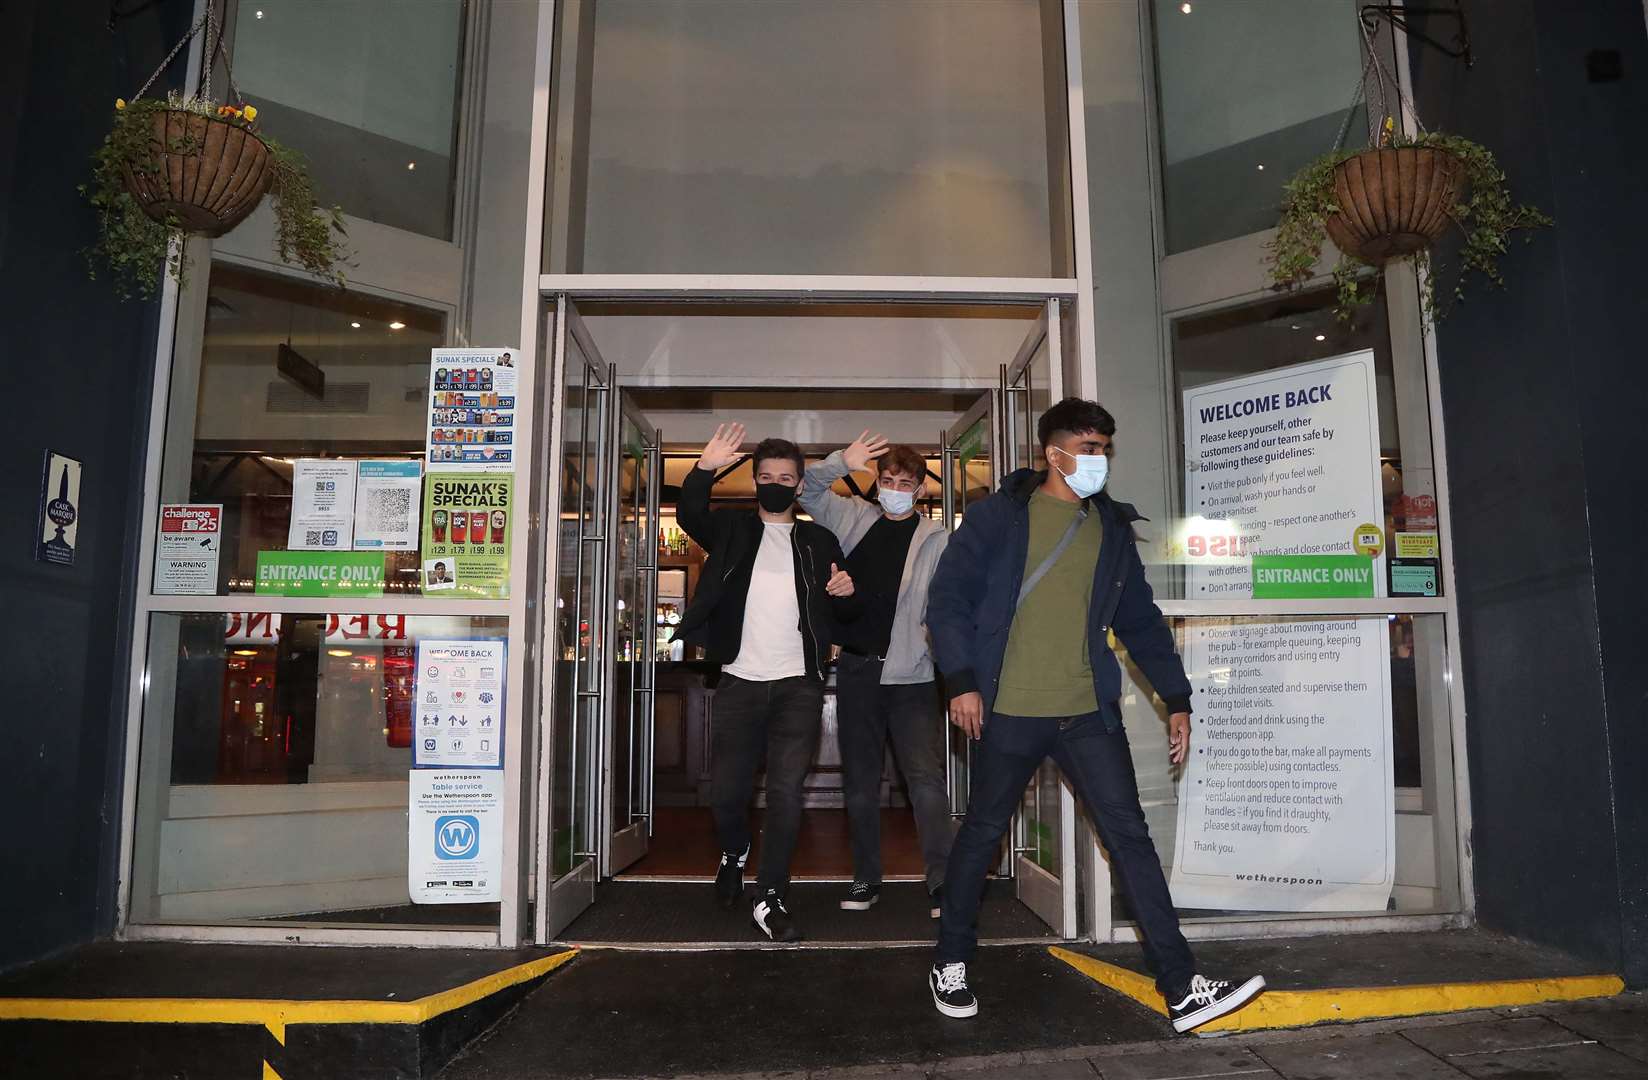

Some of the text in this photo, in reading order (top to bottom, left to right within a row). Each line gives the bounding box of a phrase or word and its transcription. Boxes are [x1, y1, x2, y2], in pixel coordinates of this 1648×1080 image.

[1200, 384, 1332, 423] WELCOME BACK
[1201, 418, 1311, 444] Please keep yourself, other
[1201, 428, 1334, 458] customers and our team safe by
[1201, 447, 1315, 472] following these guidelines:
[1208, 481, 1223, 491] Visit
[1224, 480, 1235, 489] the
[1237, 478, 1250, 489] pub
[1252, 474, 1268, 485] only
[1269, 472, 1274, 481] if
[1275, 471, 1290, 483] you
[1291, 468, 1305, 478] feel
[434, 482, 508, 495] SUNAK'S
[1208, 497, 1219, 507] On
[1244, 490, 1263, 501] wash
[1264, 488, 1281, 500] your
[1282, 484, 1306, 495] hands
[1308, 485, 1316, 493] or
[55, 502, 69, 512] CASK
[433, 496, 507, 506] SPECIALS
[50, 508, 74, 520] MARQUE
[165, 509, 211, 519] challenge
[1208, 511, 1221, 519] use
[1274, 509, 1356, 527] respect one another's
[199, 518, 216, 531] 25
[1284, 543, 1298, 554] and
[1300, 541, 1320, 553] close
[1321, 540, 1350, 551] contact
[260, 565, 381, 580] ENTRANCE ONLY
[1209, 566, 1224, 576] with
[1256, 567, 1370, 584] ENTRANCE ONLY
[1209, 581, 1252, 593] Don't arrang
[1209, 620, 1356, 638] Observe signage about moving around
[1209, 636, 1361, 653] the pub for example queuing, keeping
[1209, 650, 1340, 666] left in any corridors and using entry
[1238, 668, 1263, 679] points.
[1208, 681, 1368, 697] Keep children seated and supervise them
[1208, 700, 1232, 711] during
[1234, 698, 1252, 708] toilet
[1208, 715, 1324, 726] Order food and drink using the
[1207, 730, 1257, 741] Wetherspoon
[1207, 746, 1372, 759] If you do go to the bar, make all payments
[1206, 760, 1341, 774] (where possible) using contactless.
[1206, 777, 1337, 792] Keep front doors open to improve
[1206, 792, 1343, 805] ventilation and reduce contact with
[1205, 806, 1331, 822] handles if you find it draughty,
[1204, 820, 1310, 834] please sit away from doors.
[443, 828, 472, 847] W
[1194, 841, 1235, 855] Thank you.
[1236, 873, 1323, 885] wetherspoon
